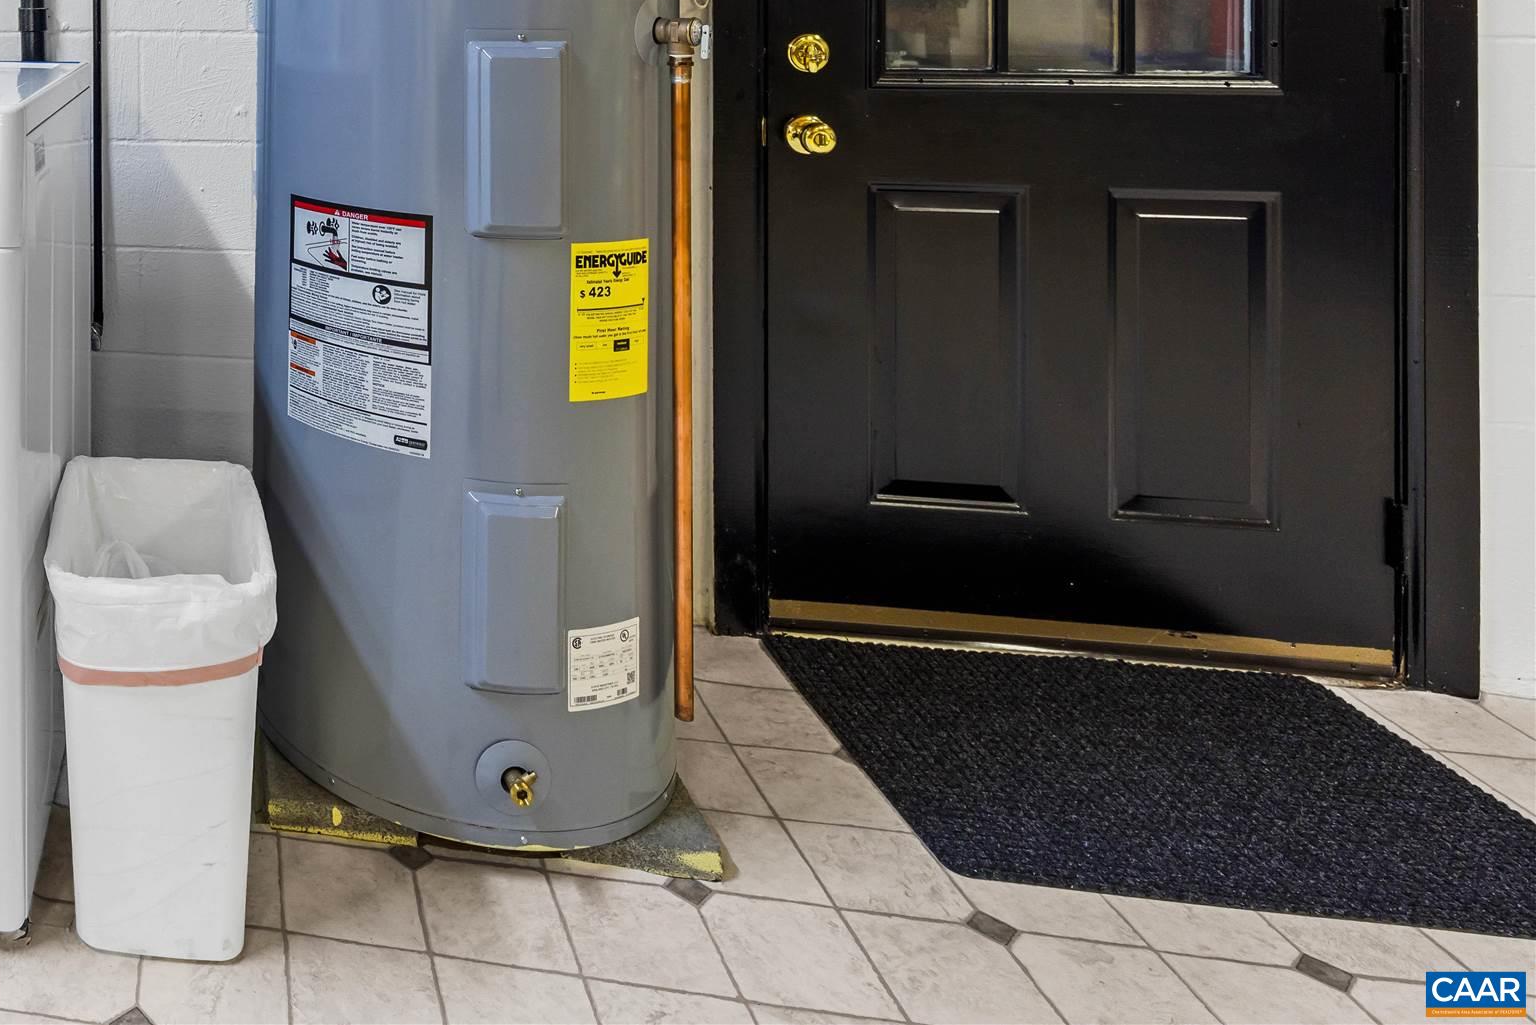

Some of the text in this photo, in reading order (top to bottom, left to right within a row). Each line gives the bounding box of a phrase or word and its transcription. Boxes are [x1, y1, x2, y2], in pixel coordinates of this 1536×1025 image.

[341, 210, 369, 221] DANGER
[575, 250, 647, 269] ENERGYGUIDE
[580, 286, 611, 299] $ 423
